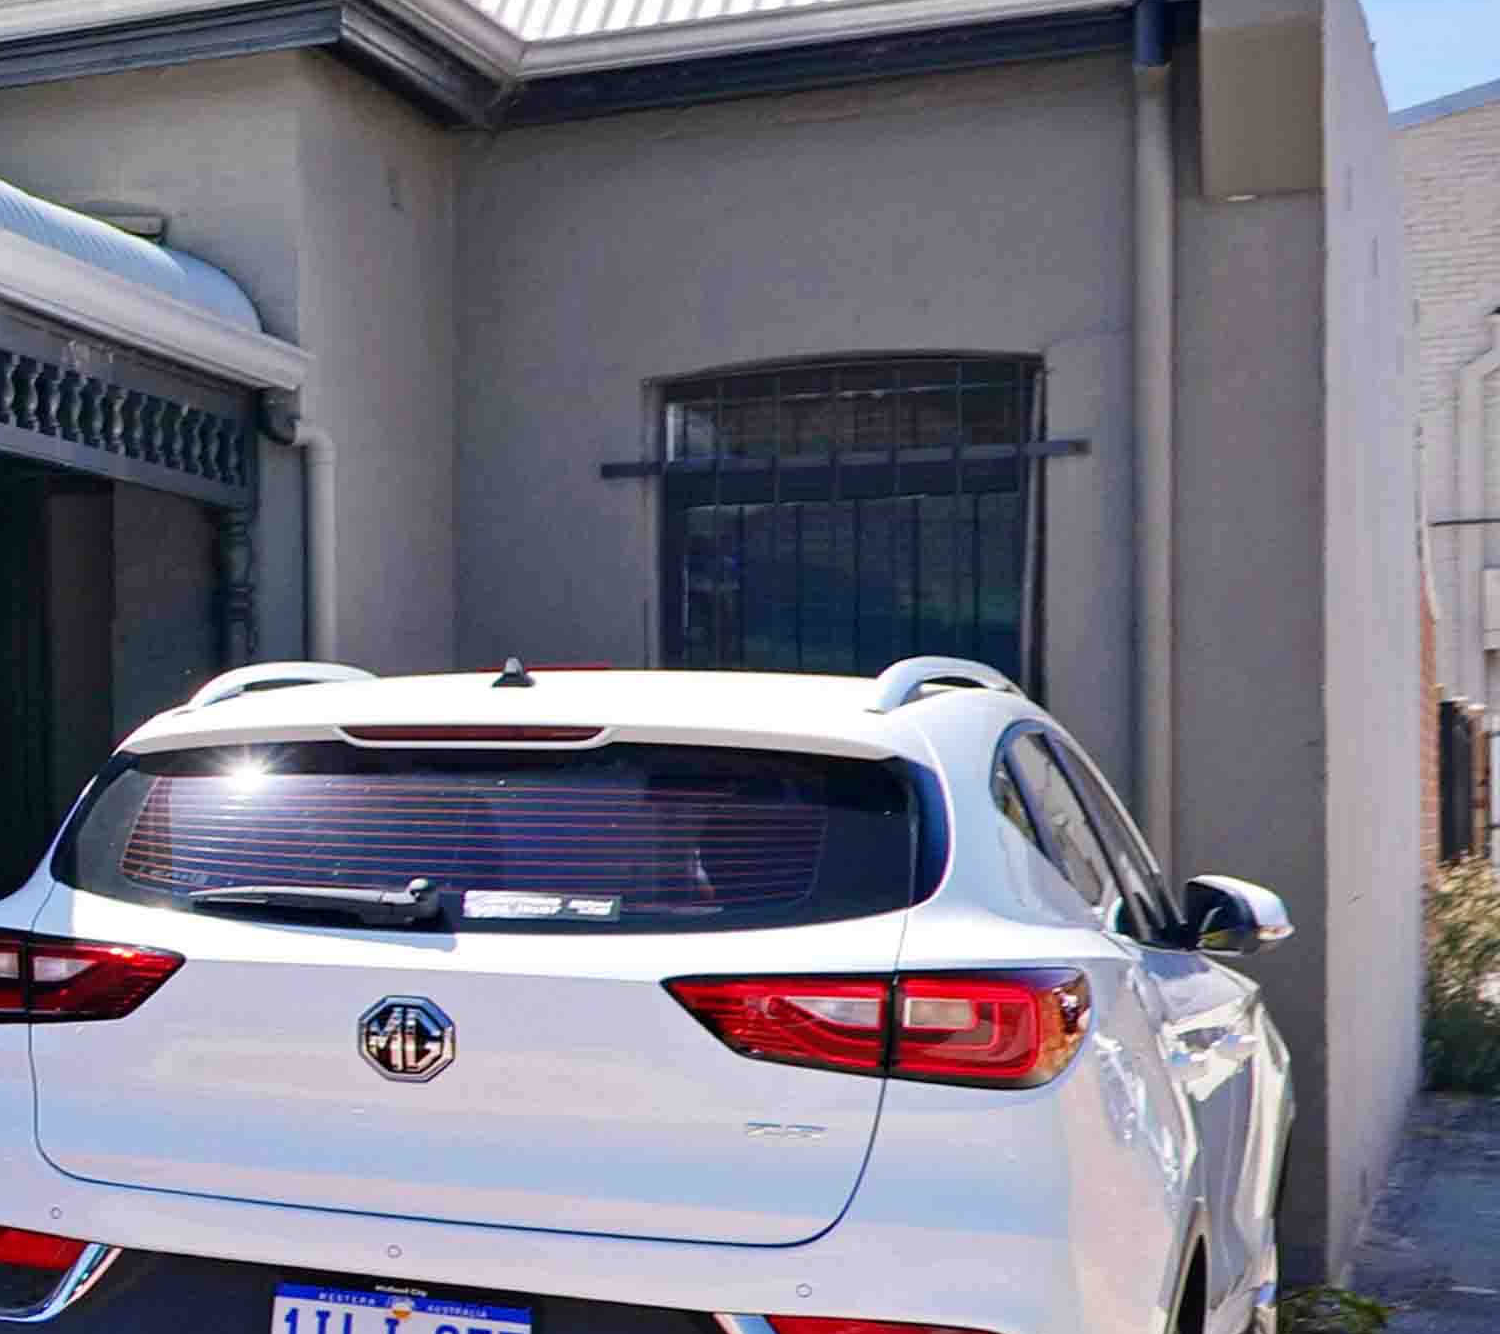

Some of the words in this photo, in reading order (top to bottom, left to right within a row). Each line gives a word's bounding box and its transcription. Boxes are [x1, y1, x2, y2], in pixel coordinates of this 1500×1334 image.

[365, 1004, 447, 1073] MG
[318, 1292, 376, 1306] WESTERN
[427, 1304, 489, 1318] AUSTRALIA
